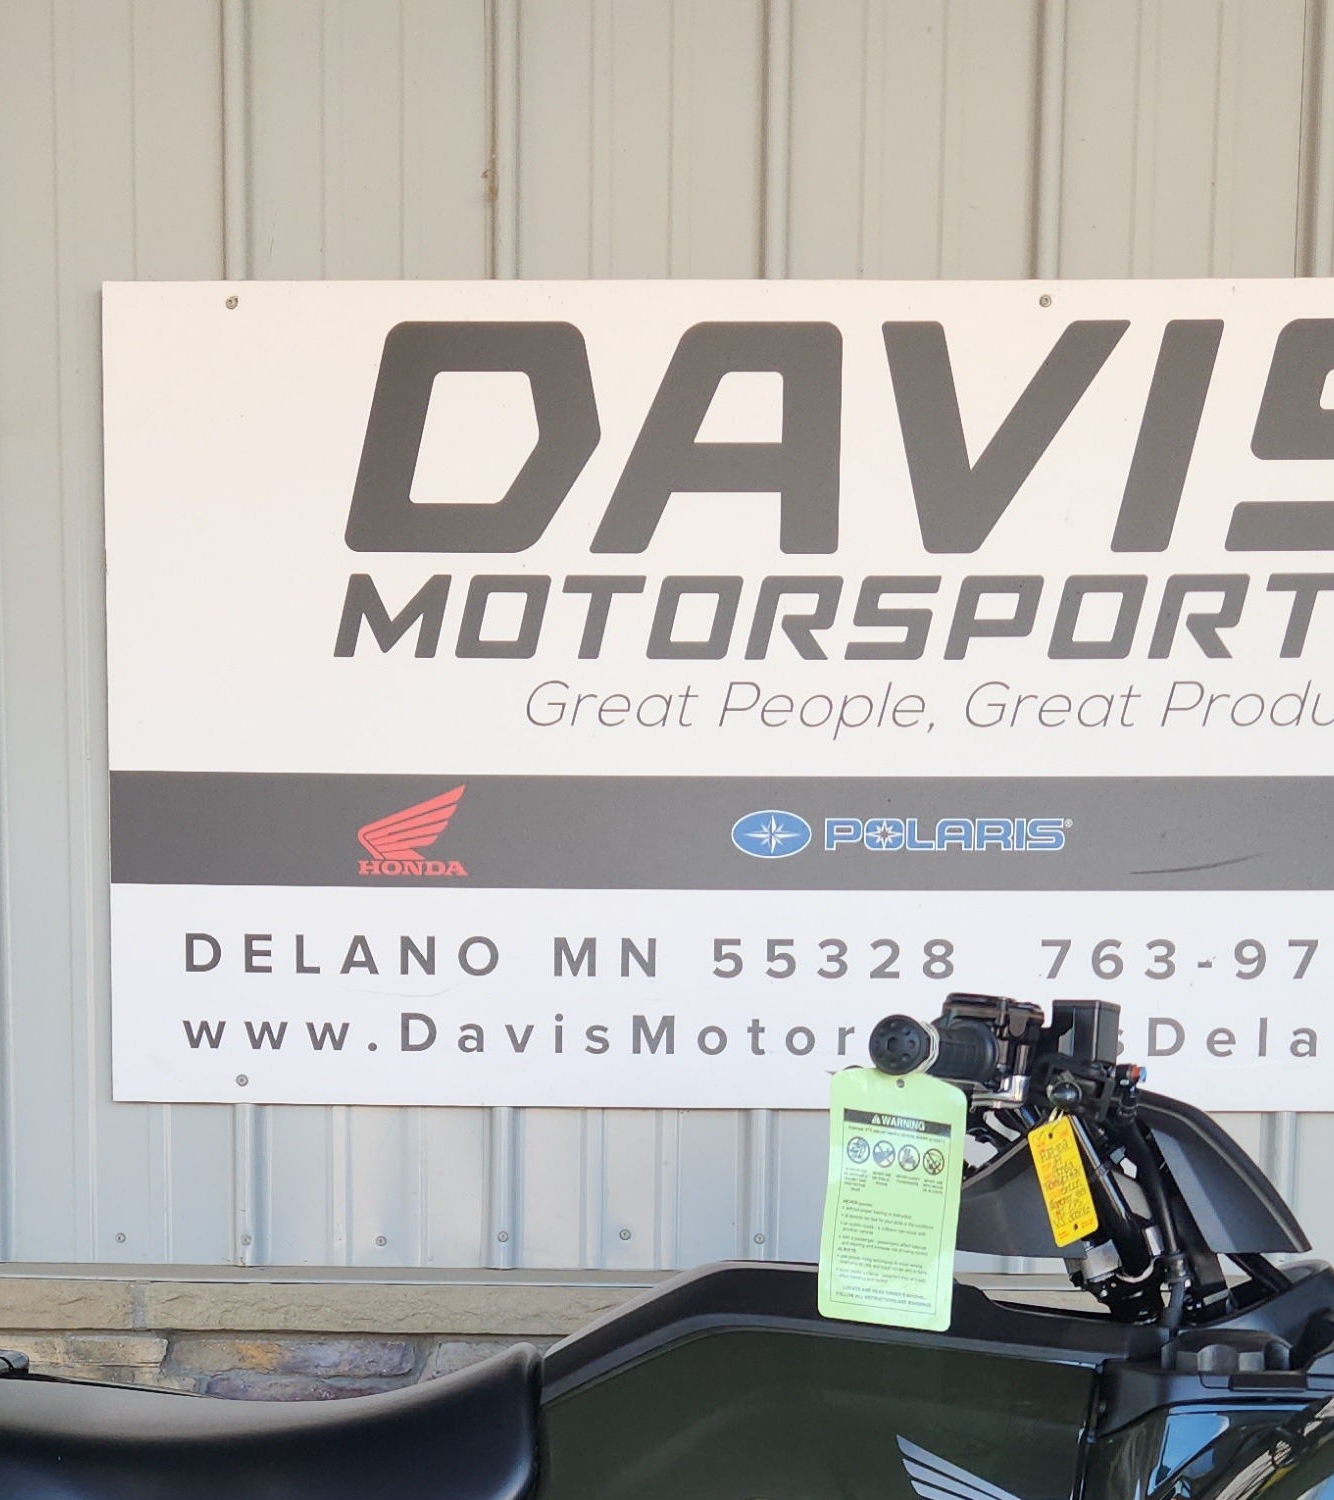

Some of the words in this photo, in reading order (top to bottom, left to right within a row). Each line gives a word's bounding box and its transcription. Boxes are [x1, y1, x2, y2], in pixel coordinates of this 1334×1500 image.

[525, 680, 699, 728] Great
[717, 680, 936, 740] People,
[965, 680, 1142, 728] Great
[824, 818, 1066, 851] POLARIS
[358, 860, 468, 876] HONDA
[185, 933, 499, 978] DELANO
[553, 936, 657, 978] MN
[712, 938, 955, 980] 55328
[881, 1114, 925, 1131] WARNING
